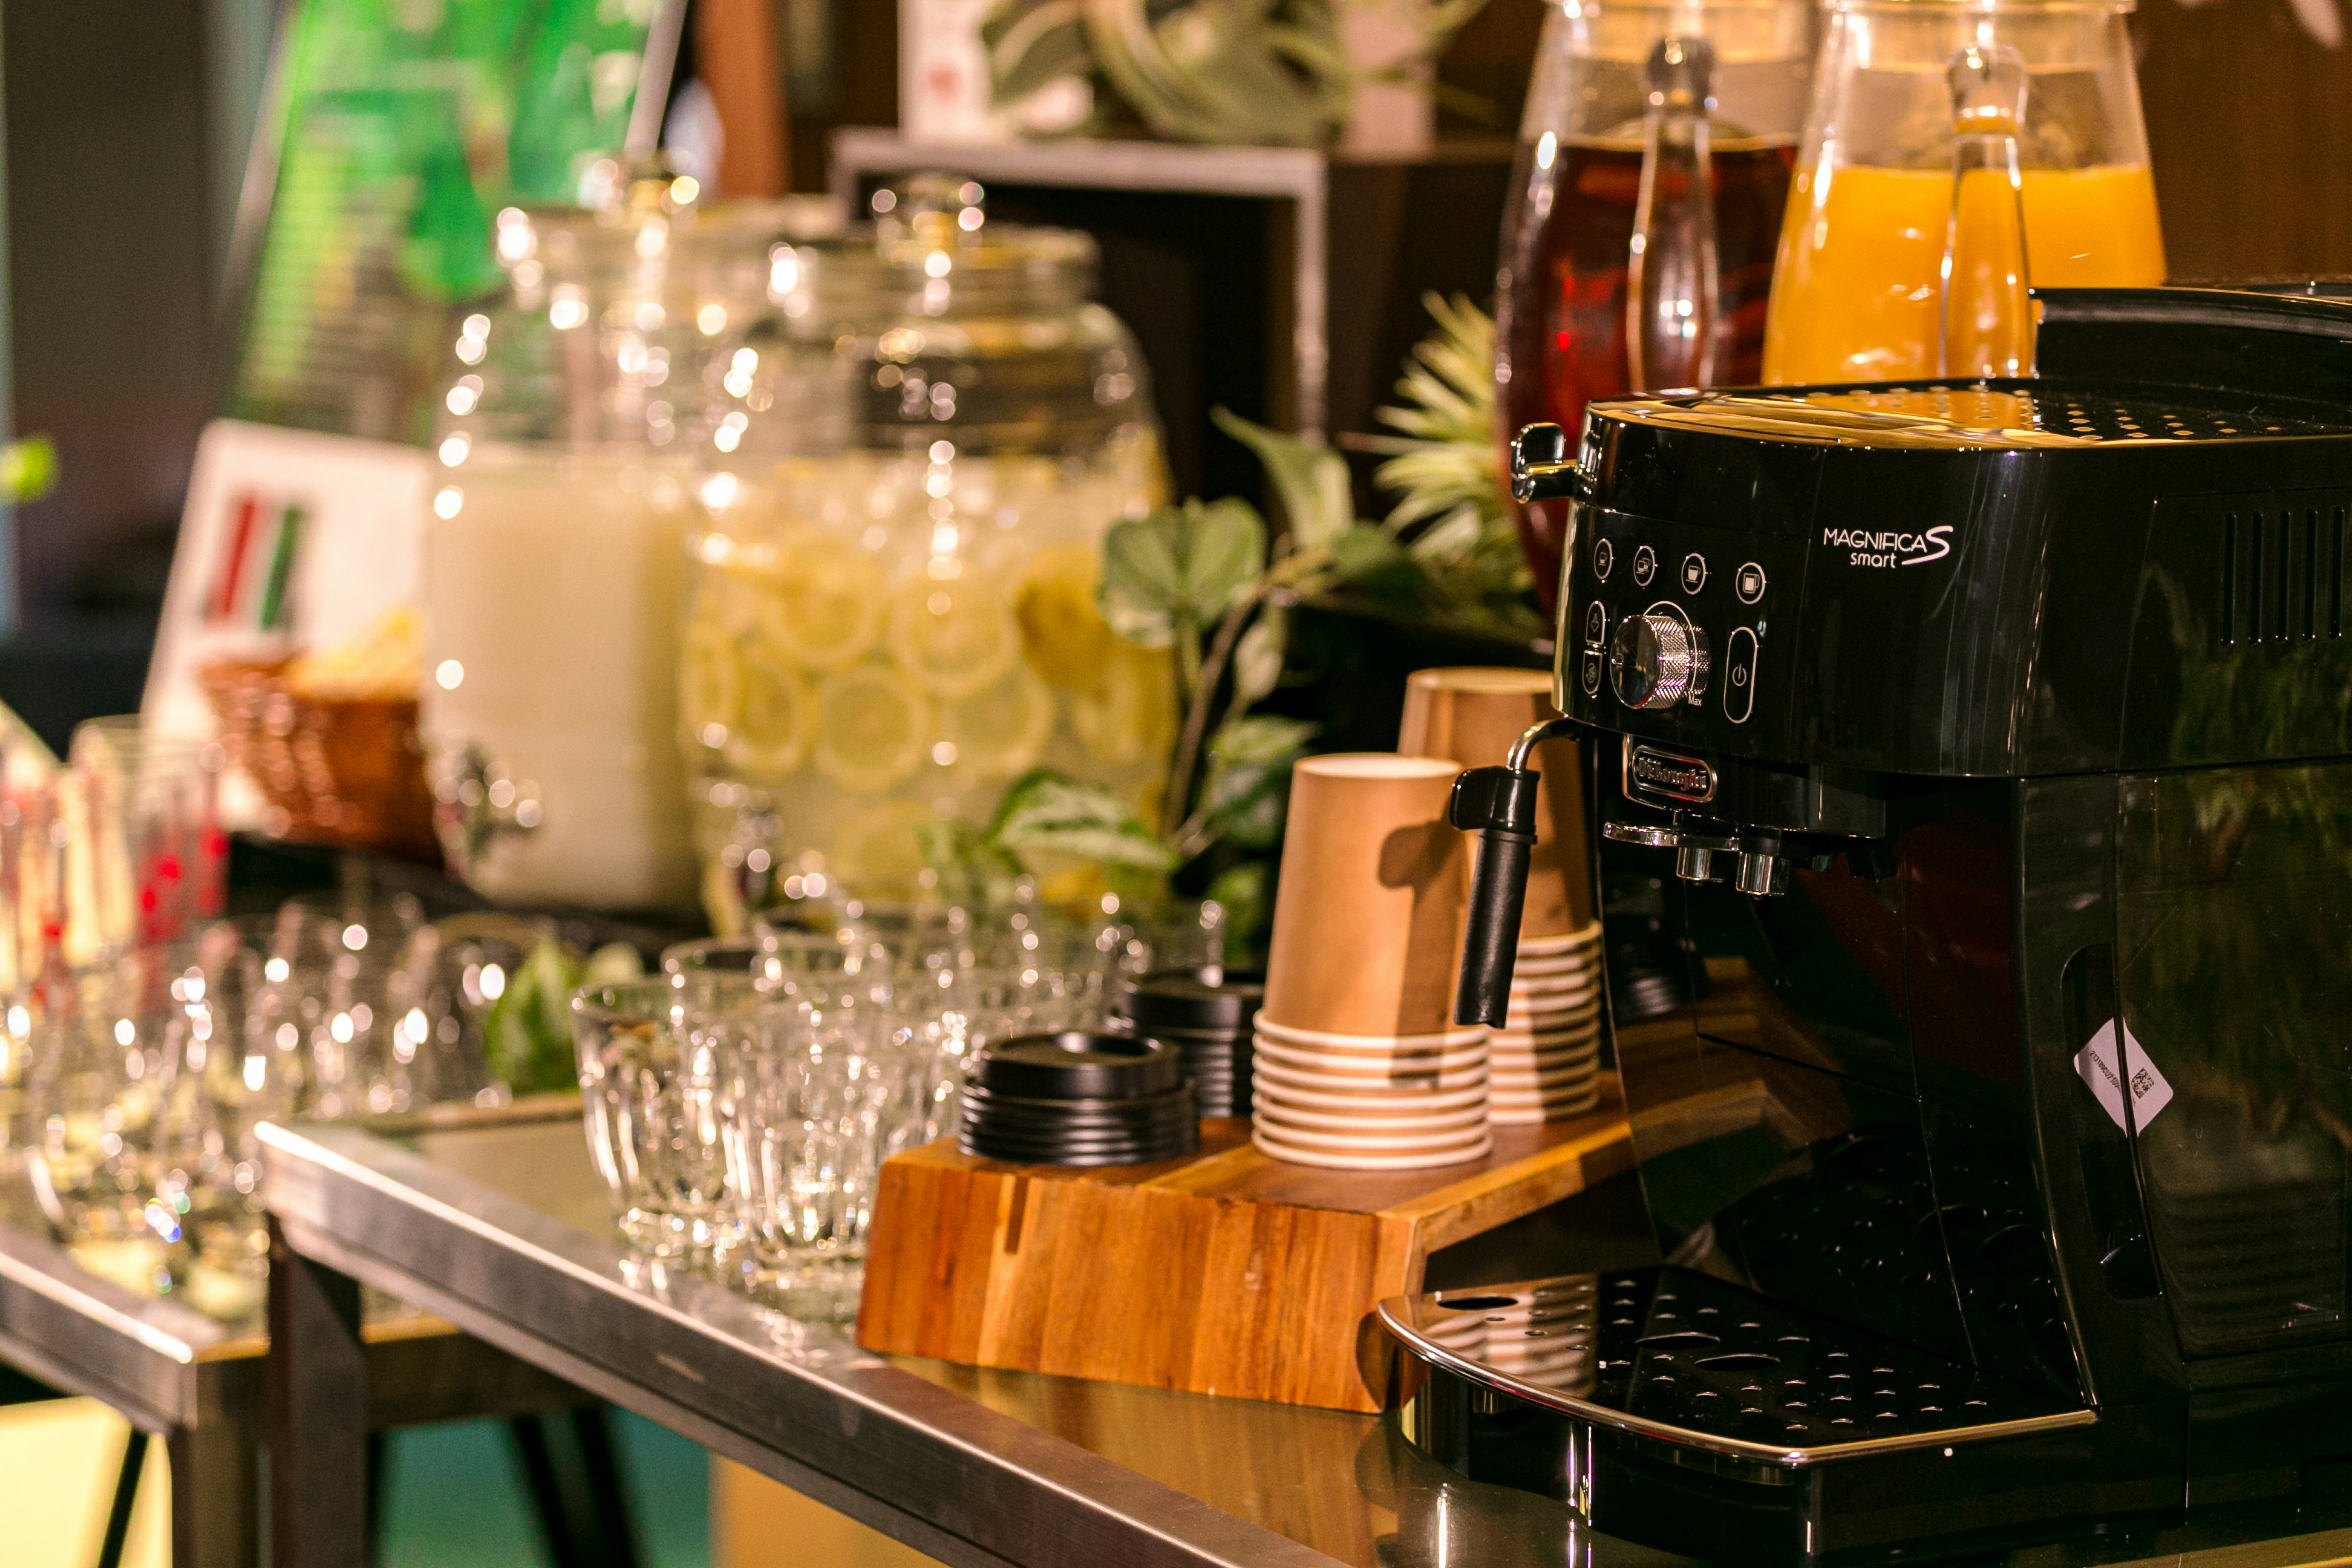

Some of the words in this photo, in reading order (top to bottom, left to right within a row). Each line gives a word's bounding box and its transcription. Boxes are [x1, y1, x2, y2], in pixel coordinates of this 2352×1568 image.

[1823, 528, 1927, 553] MAGNIFICA
[1850, 552, 1896, 568] smart
[1688, 696, 1702, 707] Max
